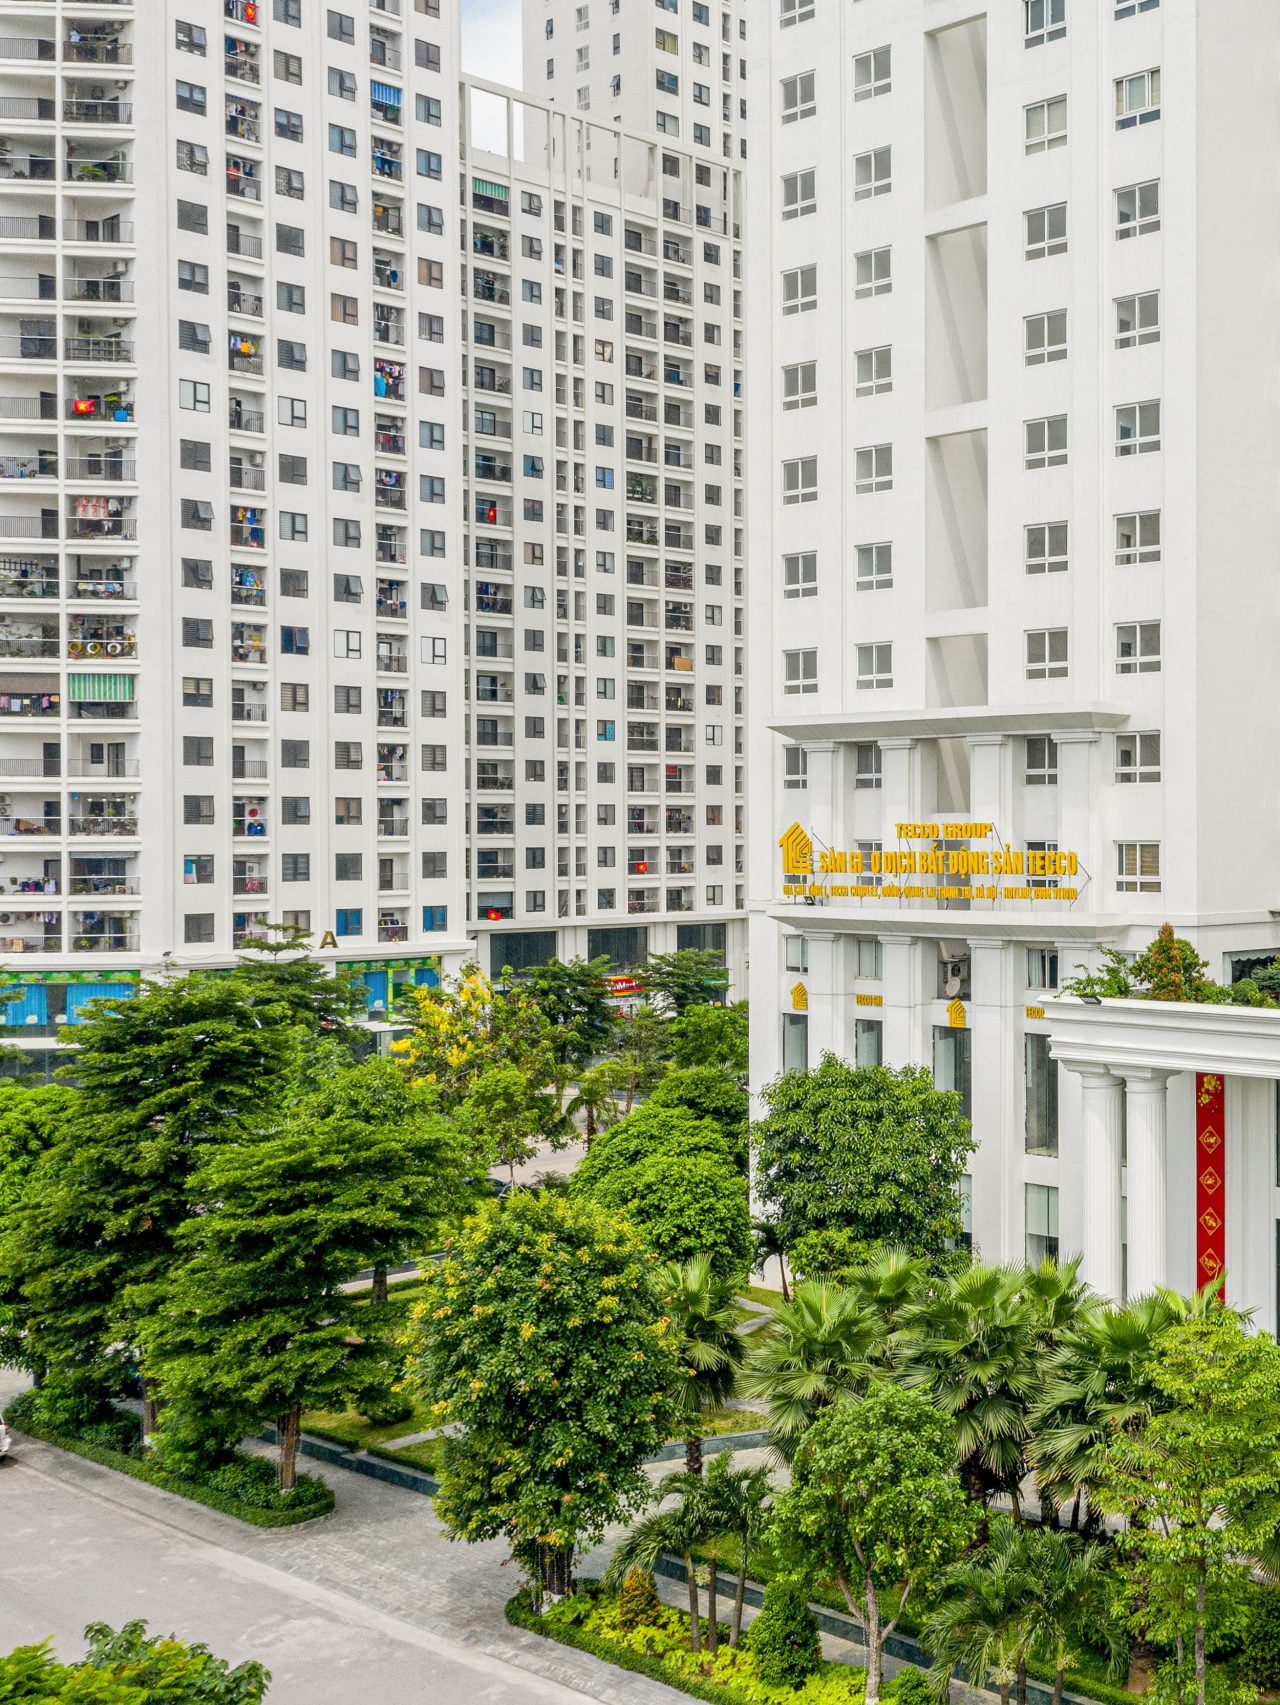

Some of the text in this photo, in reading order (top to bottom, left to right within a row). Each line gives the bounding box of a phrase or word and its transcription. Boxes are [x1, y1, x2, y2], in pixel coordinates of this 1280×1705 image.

[896, 823, 992, 838] TECCO GROUP
[819, 847, 846, 873] SÀN
[884, 851, 916, 878] DỊCH
[919, 842, 944, 874] BẤT
[949, 845, 989, 879] ĐỘNG
[991, 843, 1024, 874] SẢN
[1026, 851, 1078, 875] TECCO
[319, 931, 338, 949] A
